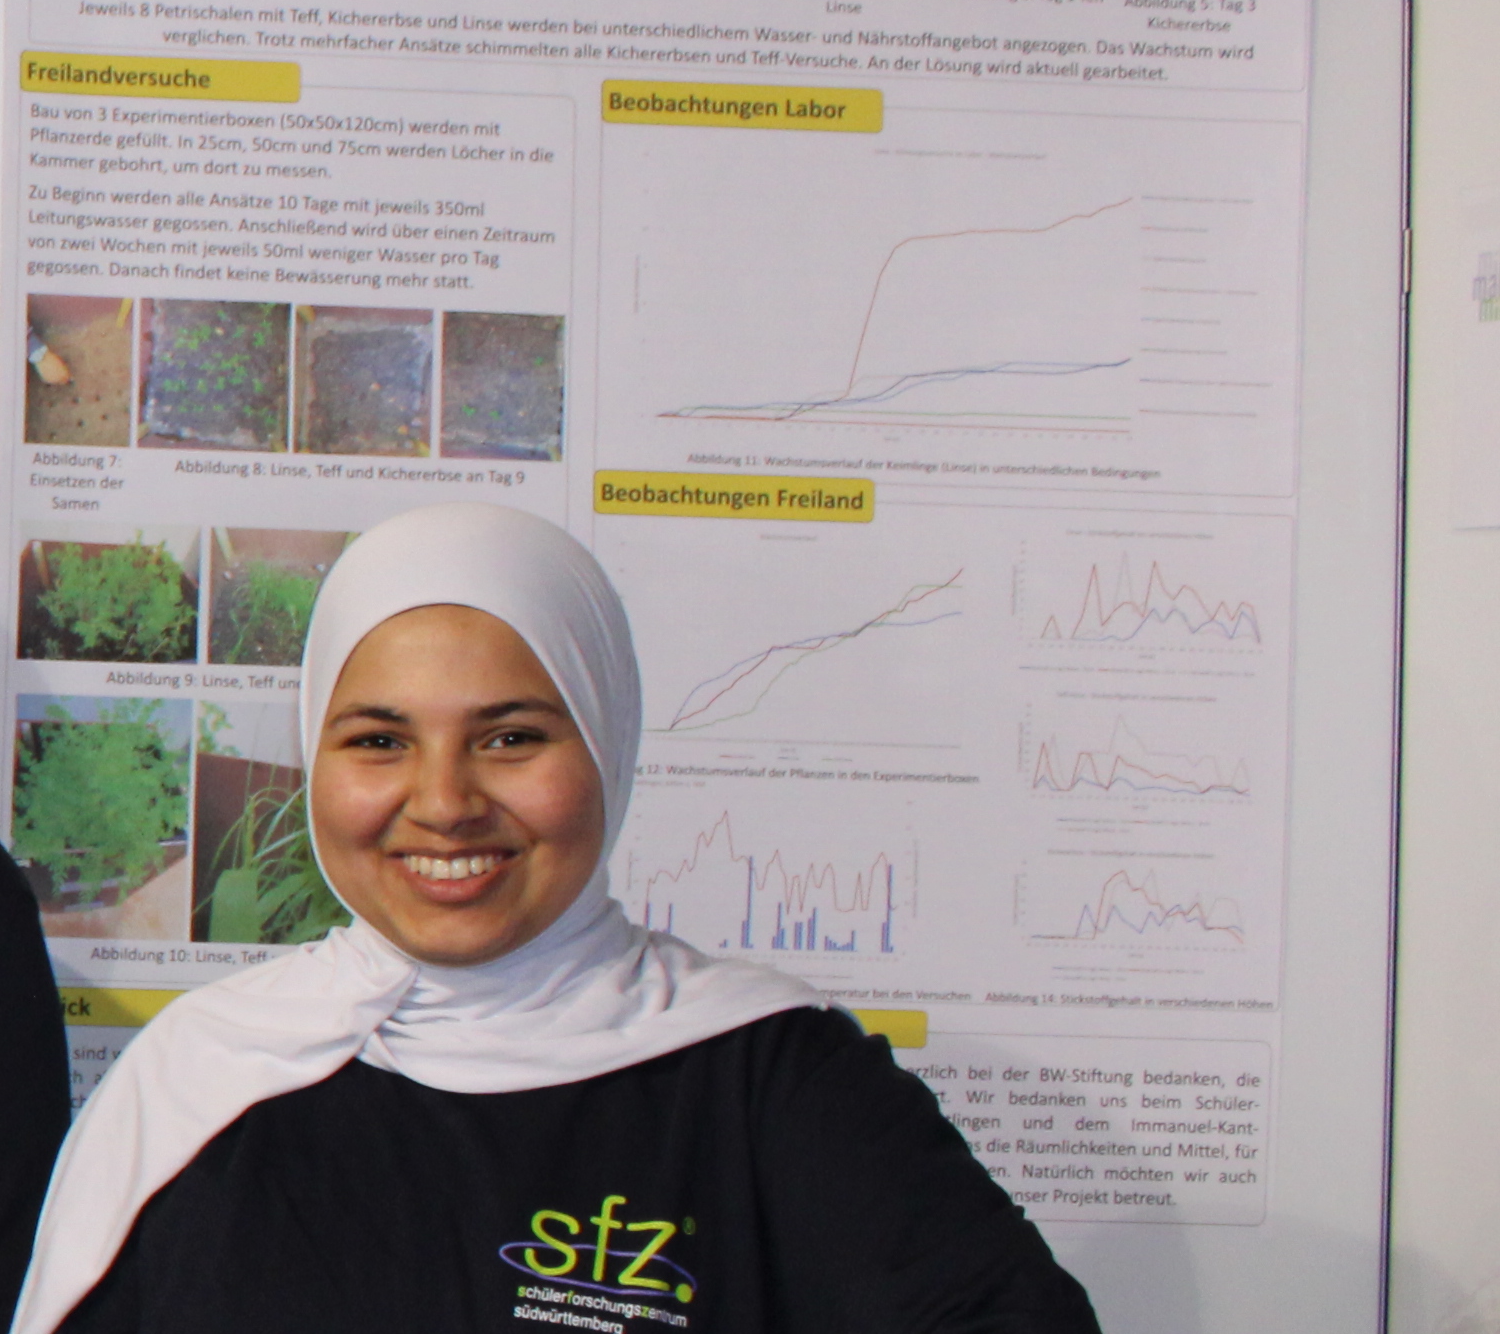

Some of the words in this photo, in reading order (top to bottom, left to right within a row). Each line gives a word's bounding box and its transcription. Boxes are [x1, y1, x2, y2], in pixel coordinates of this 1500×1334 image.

[26, 62, 210, 89] Freilandversuche
[30, 103, 59, 119] Bau
[64, 109, 93, 120] von
[112, 107, 275, 128] Experimentierboxen
[408, 120, 469, 134] werden
[474, 123, 500, 136] mit
[605, 92, 778, 120] Beobachtungen
[785, 98, 845, 120] Labor
[28, 237, 55, 248] von
[60, 237, 95, 251] zwei
[100, 238, 166, 253] Wochen
[171, 241, 198, 255] mit
[202, 241, 258, 259] jeweils
[263, 243, 303, 258] 50ml
[308, 248, 373, 264] weniger
[377, 248, 436, 263] Wasser
[441, 253, 468, 267] pro
[473, 250, 500, 270] Tag
[600, 483, 769, 510] Beobachtungen
[777, 489, 863, 511] Freiland
[966, 1090, 995, 1104] Wir
[1008, 1091, 1086, 1107] bedanken
[1100, 1096, 1127, 1108] uns
[1141, 1094, 1181, 1109] beim
[1195, 1096, 1259, 1111] Schüler-
[517, 1284, 688, 1328] schülerforschungszentrum
